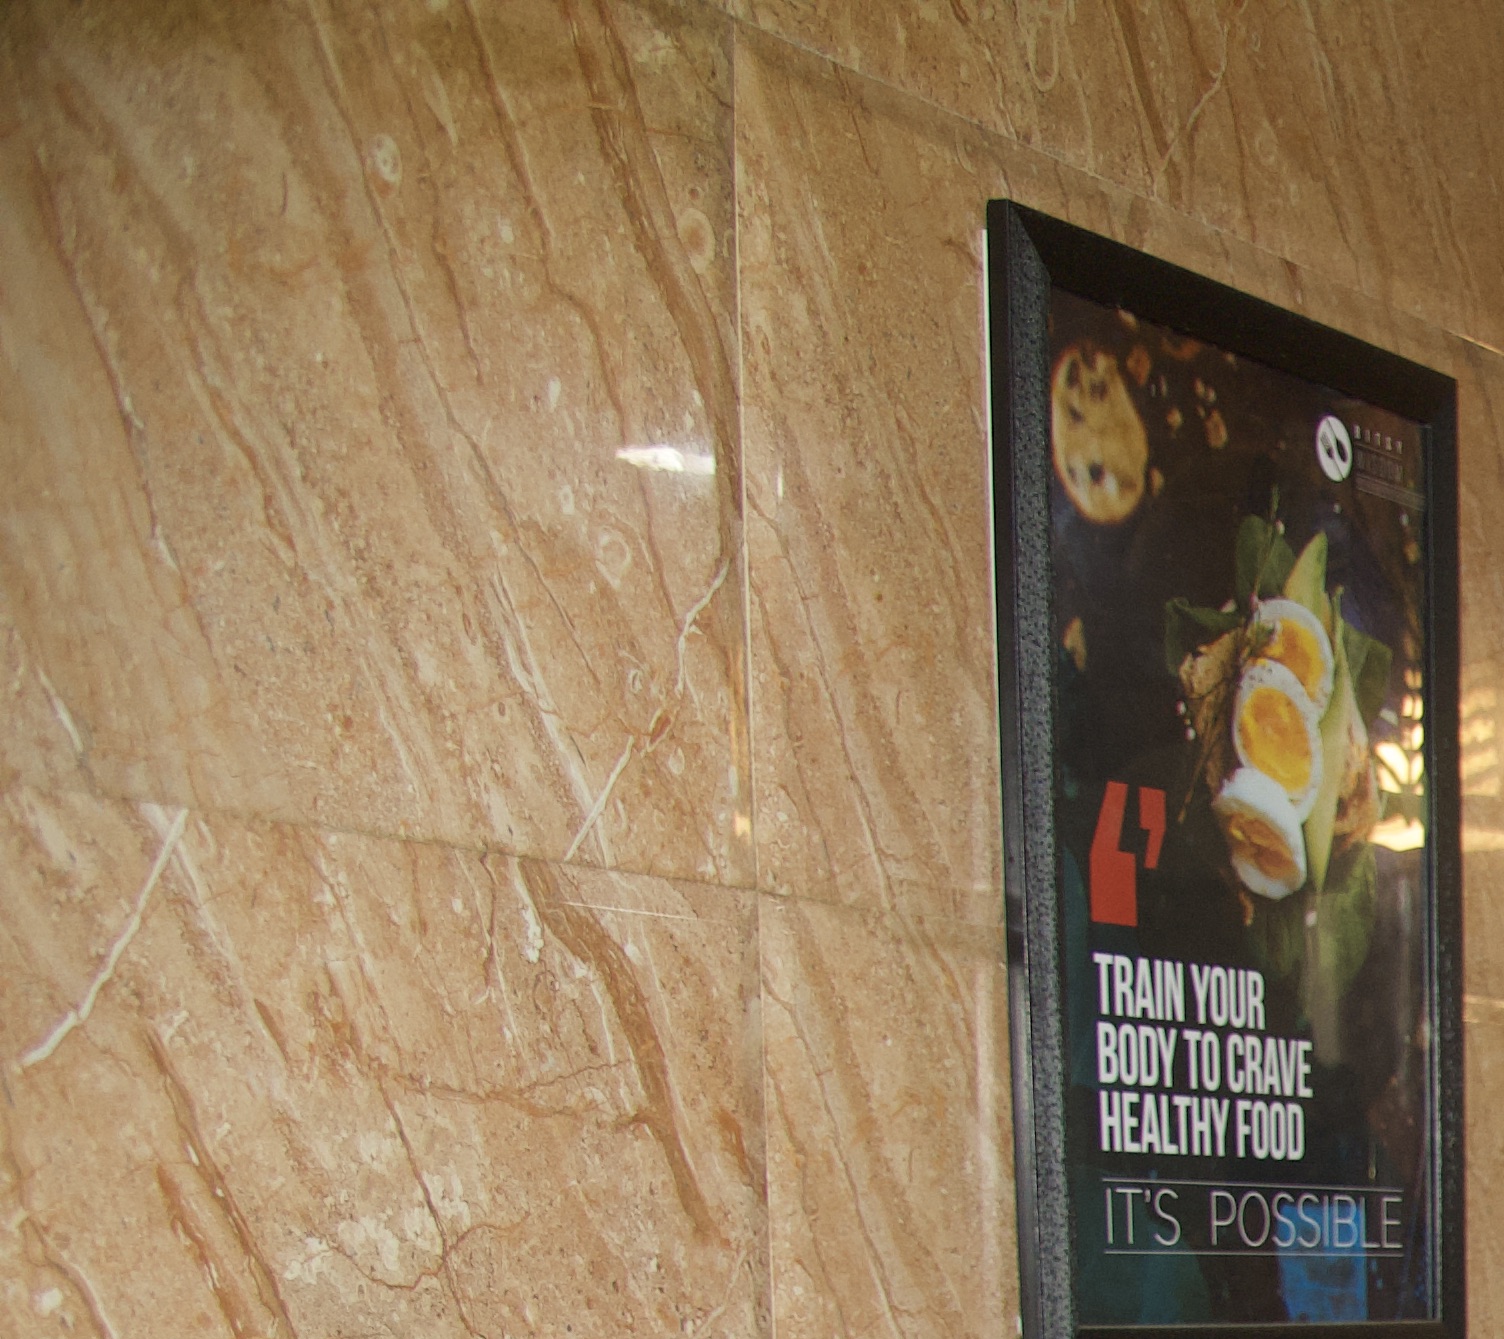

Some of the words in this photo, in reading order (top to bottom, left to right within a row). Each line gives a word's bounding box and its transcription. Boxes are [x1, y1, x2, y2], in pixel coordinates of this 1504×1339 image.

[1093, 952, 1186, 1022] TRAIN
[1190, 963, 1266, 1031] YOUR
[1097, 1021, 1178, 1088] BODY
[1183, 1028, 1221, 1092] TO
[1226, 1034, 1314, 1098] CRAVE
[1099, 1090, 1230, 1157] HEALTHY
[1235, 1100, 1306, 1161] FOOD
[1105, 1188, 1182, 1246] IT'S
[1210, 1190, 1403, 1248] POSSIBLE
